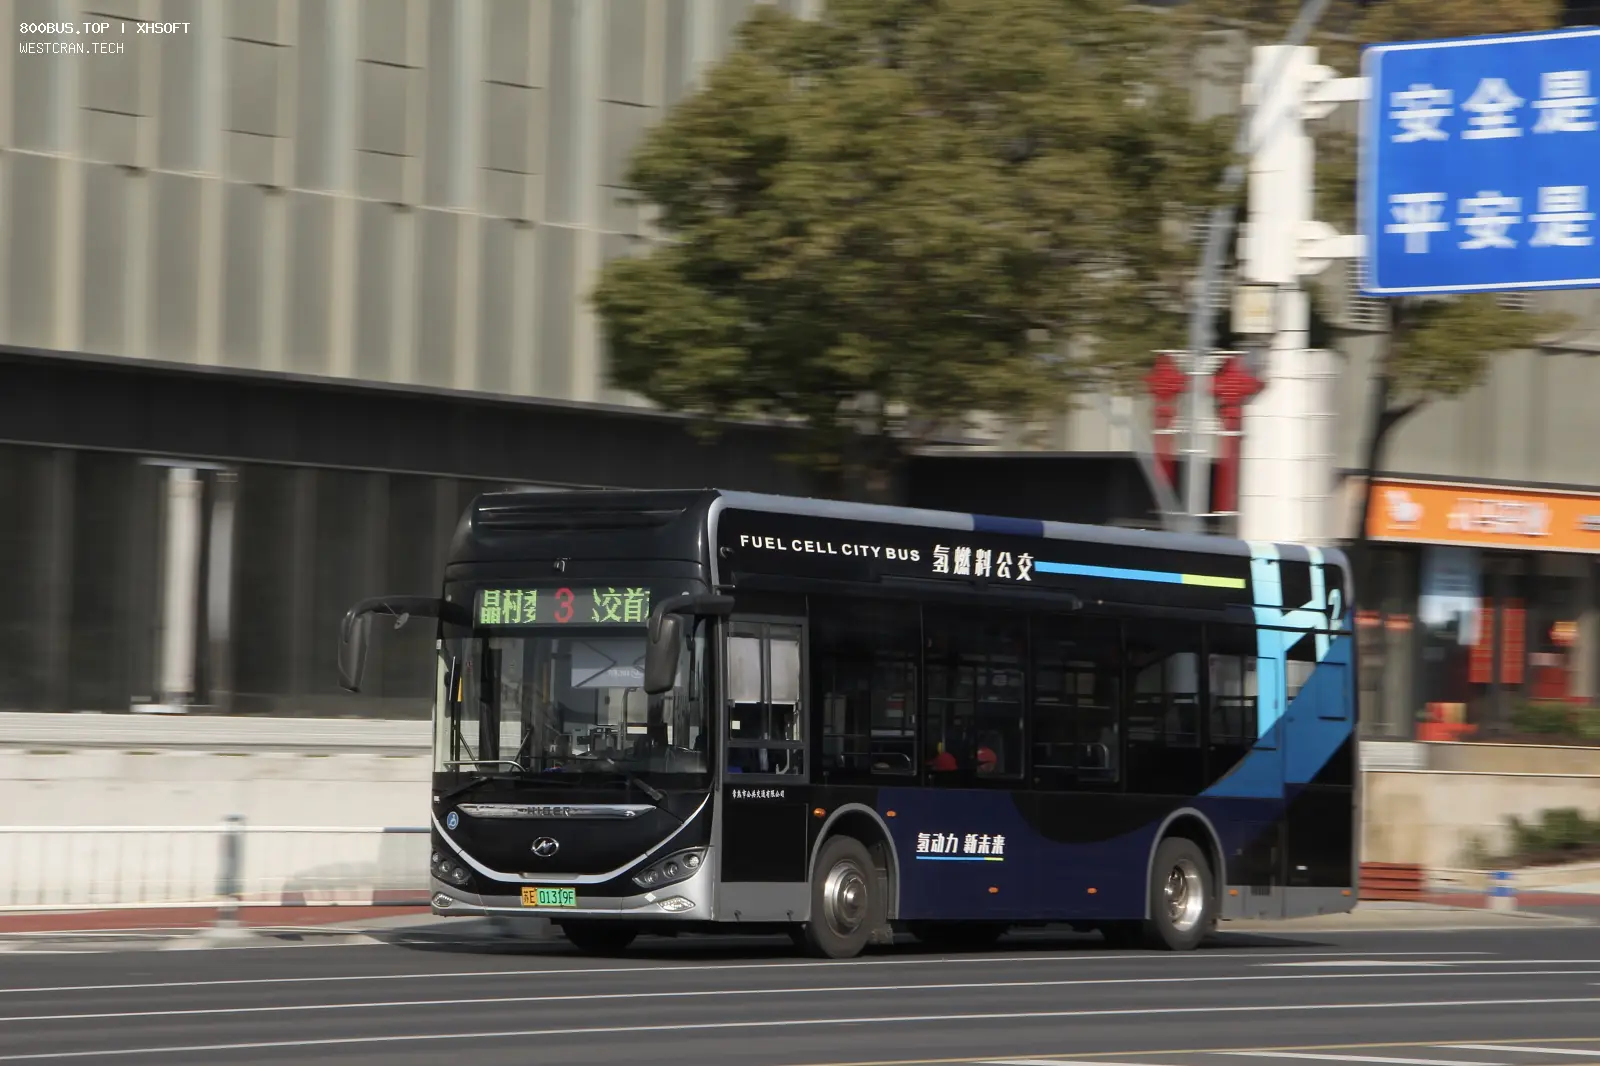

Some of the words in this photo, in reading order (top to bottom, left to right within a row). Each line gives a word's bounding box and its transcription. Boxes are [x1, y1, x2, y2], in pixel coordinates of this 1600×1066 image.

[1388, 70, 1600, 143] 安全是
[1384, 186, 1597, 254] 平安是
[740, 534, 787, 552] FUEL
[791, 539, 838, 555] CELL
[841, 543, 882, 558] CITY
[885, 547, 921, 562] BUS
[931, 543, 1035, 582] 氢燃料公交
[553, 587, 575, 624] 3
[527, 805, 571, 817] HIGER
[916, 832, 959, 854] 氢动力
[963, 833, 1006, 855] 新未来
